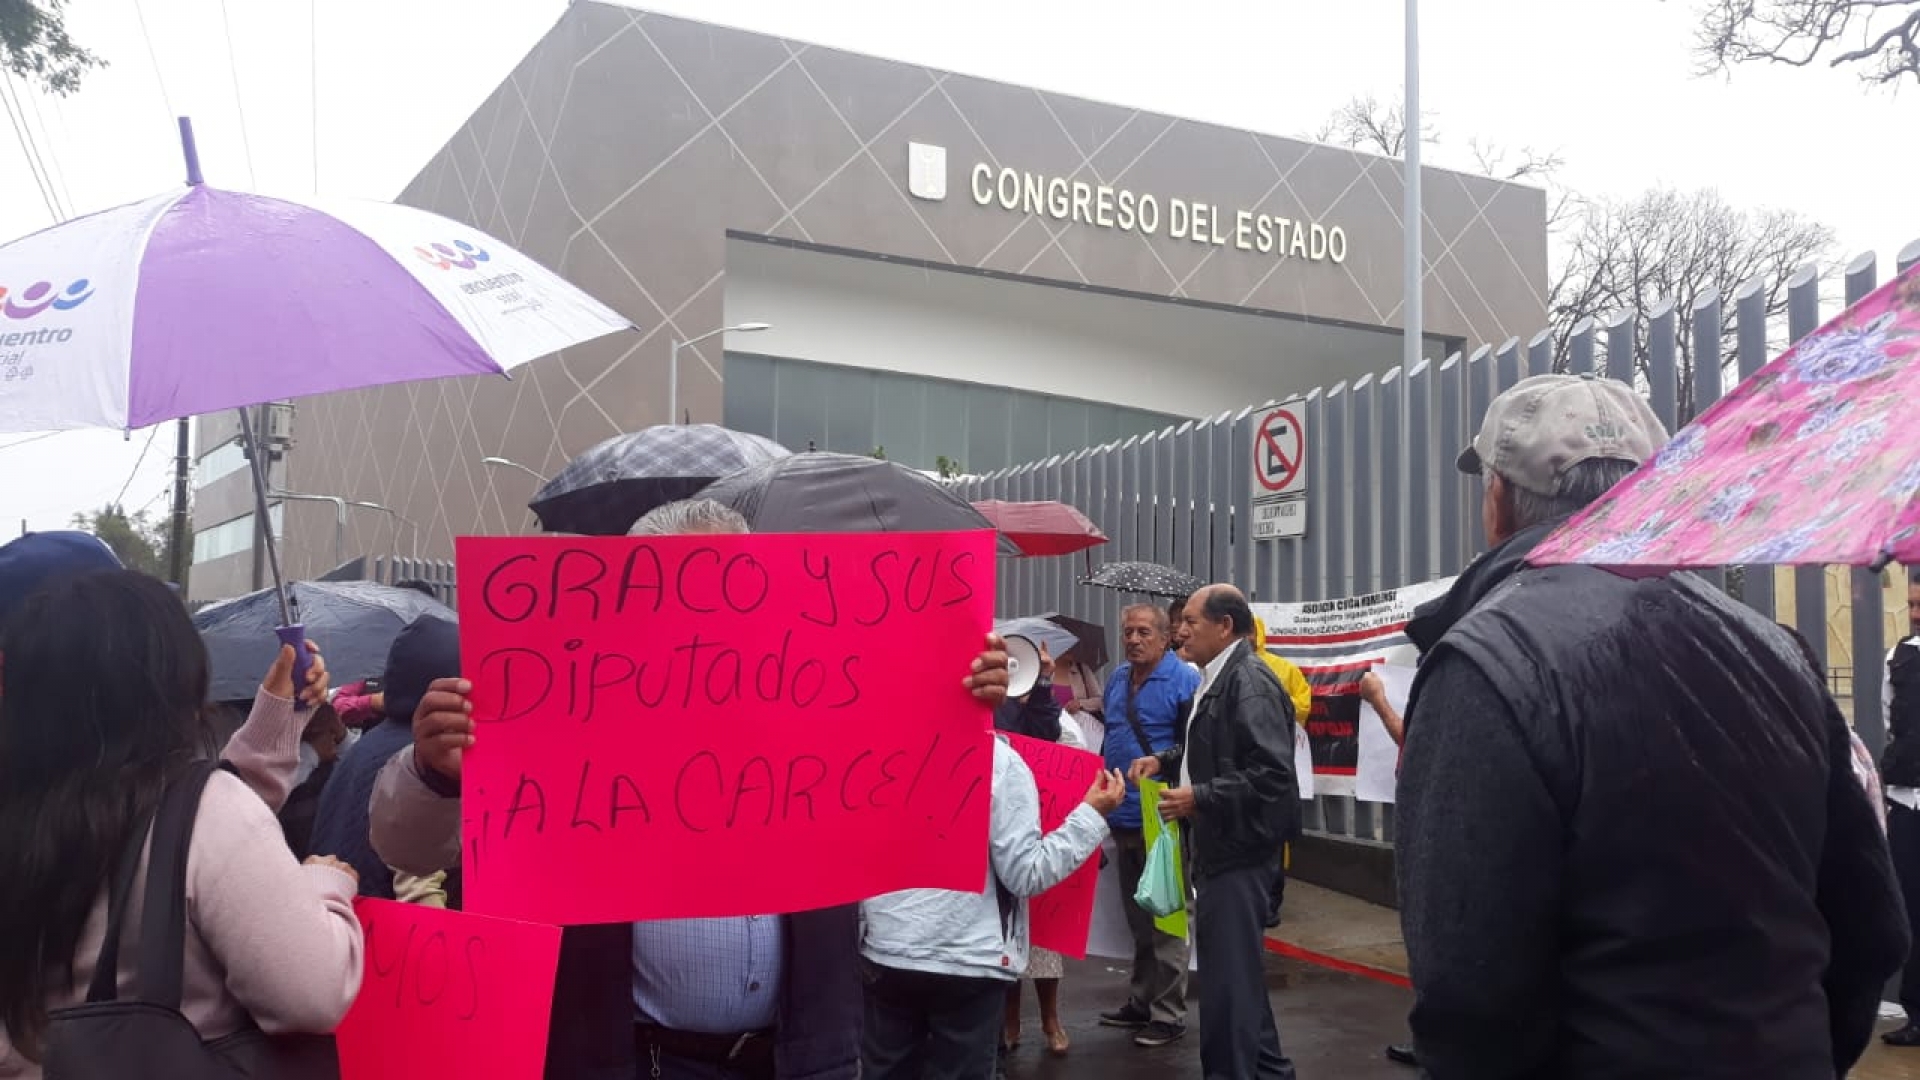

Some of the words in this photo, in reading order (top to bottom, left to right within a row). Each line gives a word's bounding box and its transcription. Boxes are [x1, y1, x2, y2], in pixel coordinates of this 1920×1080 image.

[972, 163, 1159, 234] CONGRESO
[1170, 199, 1225, 245] DEL
[1236, 211, 1347, 263] ESTADO
[483, 545, 769, 622] GRACO
[855, 549, 975, 627] SUS
[571, 761, 651, 830] LA
